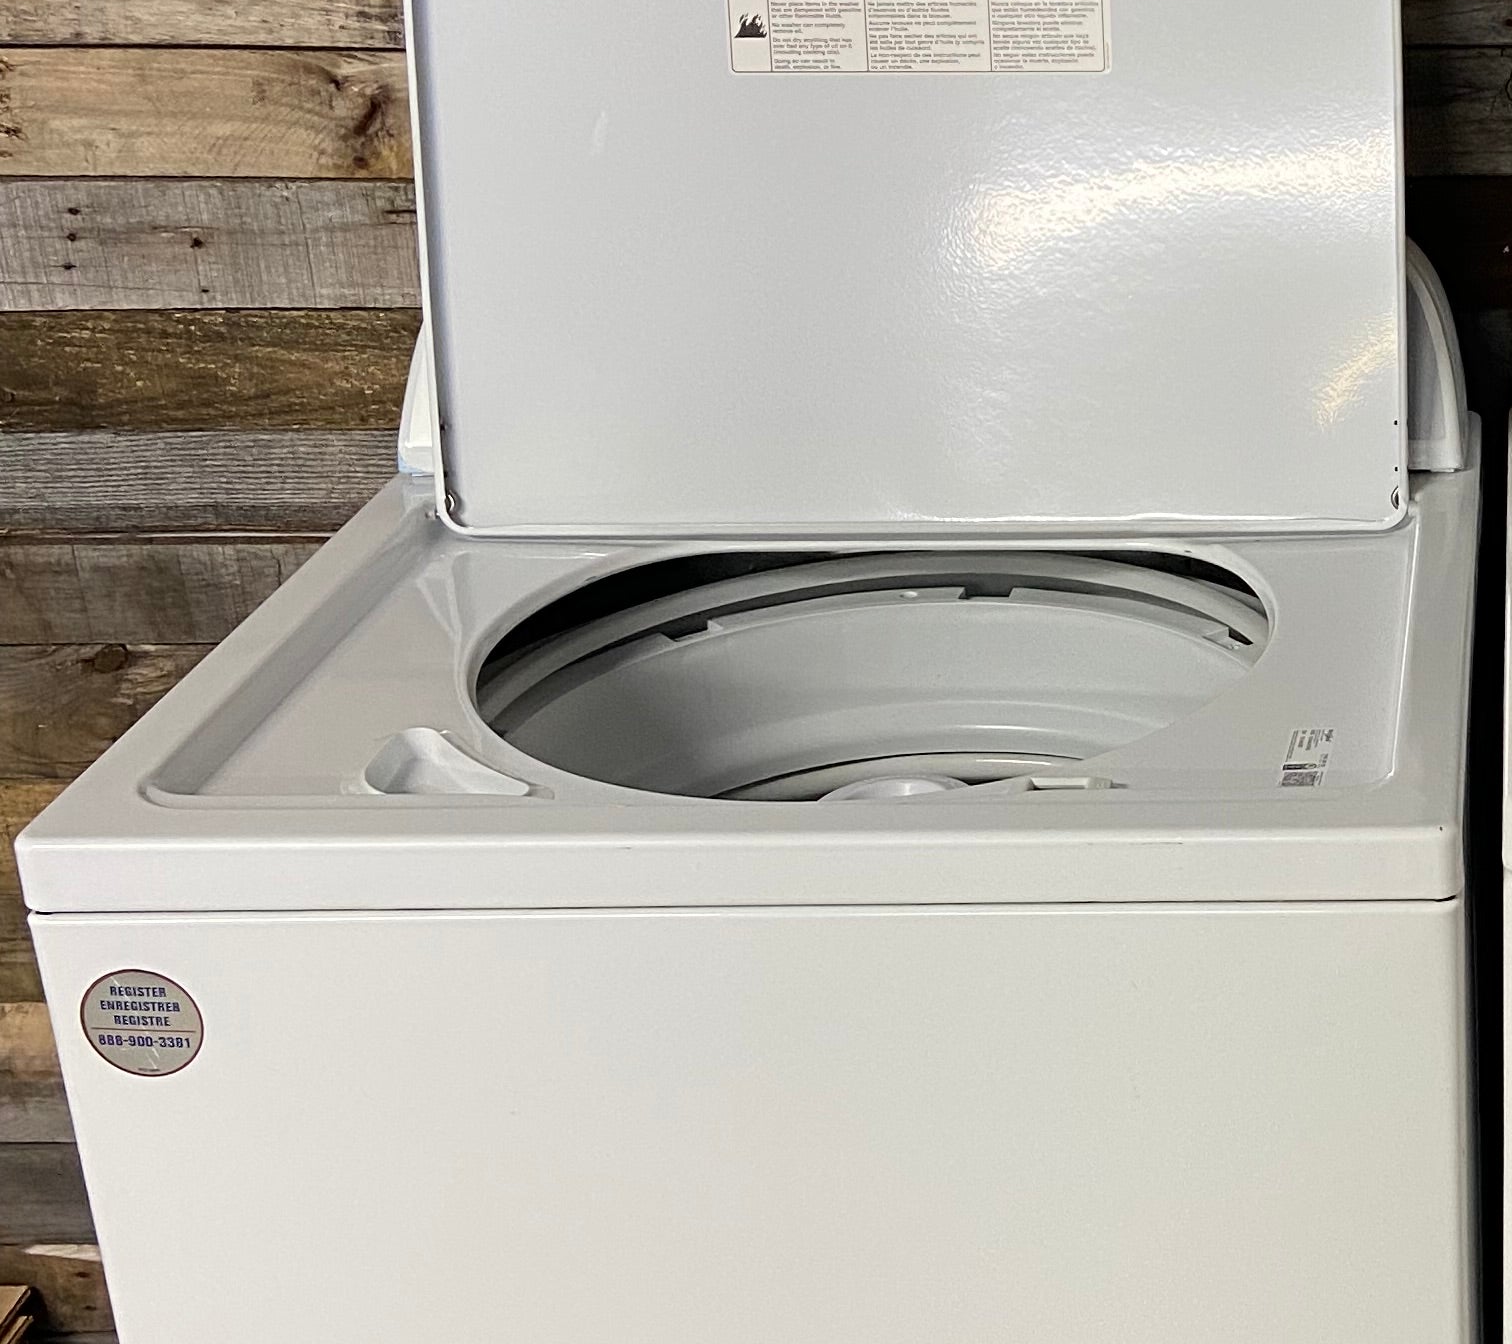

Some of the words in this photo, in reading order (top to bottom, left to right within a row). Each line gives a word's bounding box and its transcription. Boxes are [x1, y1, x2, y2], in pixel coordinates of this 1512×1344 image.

[109, 986, 167, 997] REGISTER
[100, 1000, 181, 1012] ENREGISTRER
[113, 1015, 171, 1027] REGISTRE
